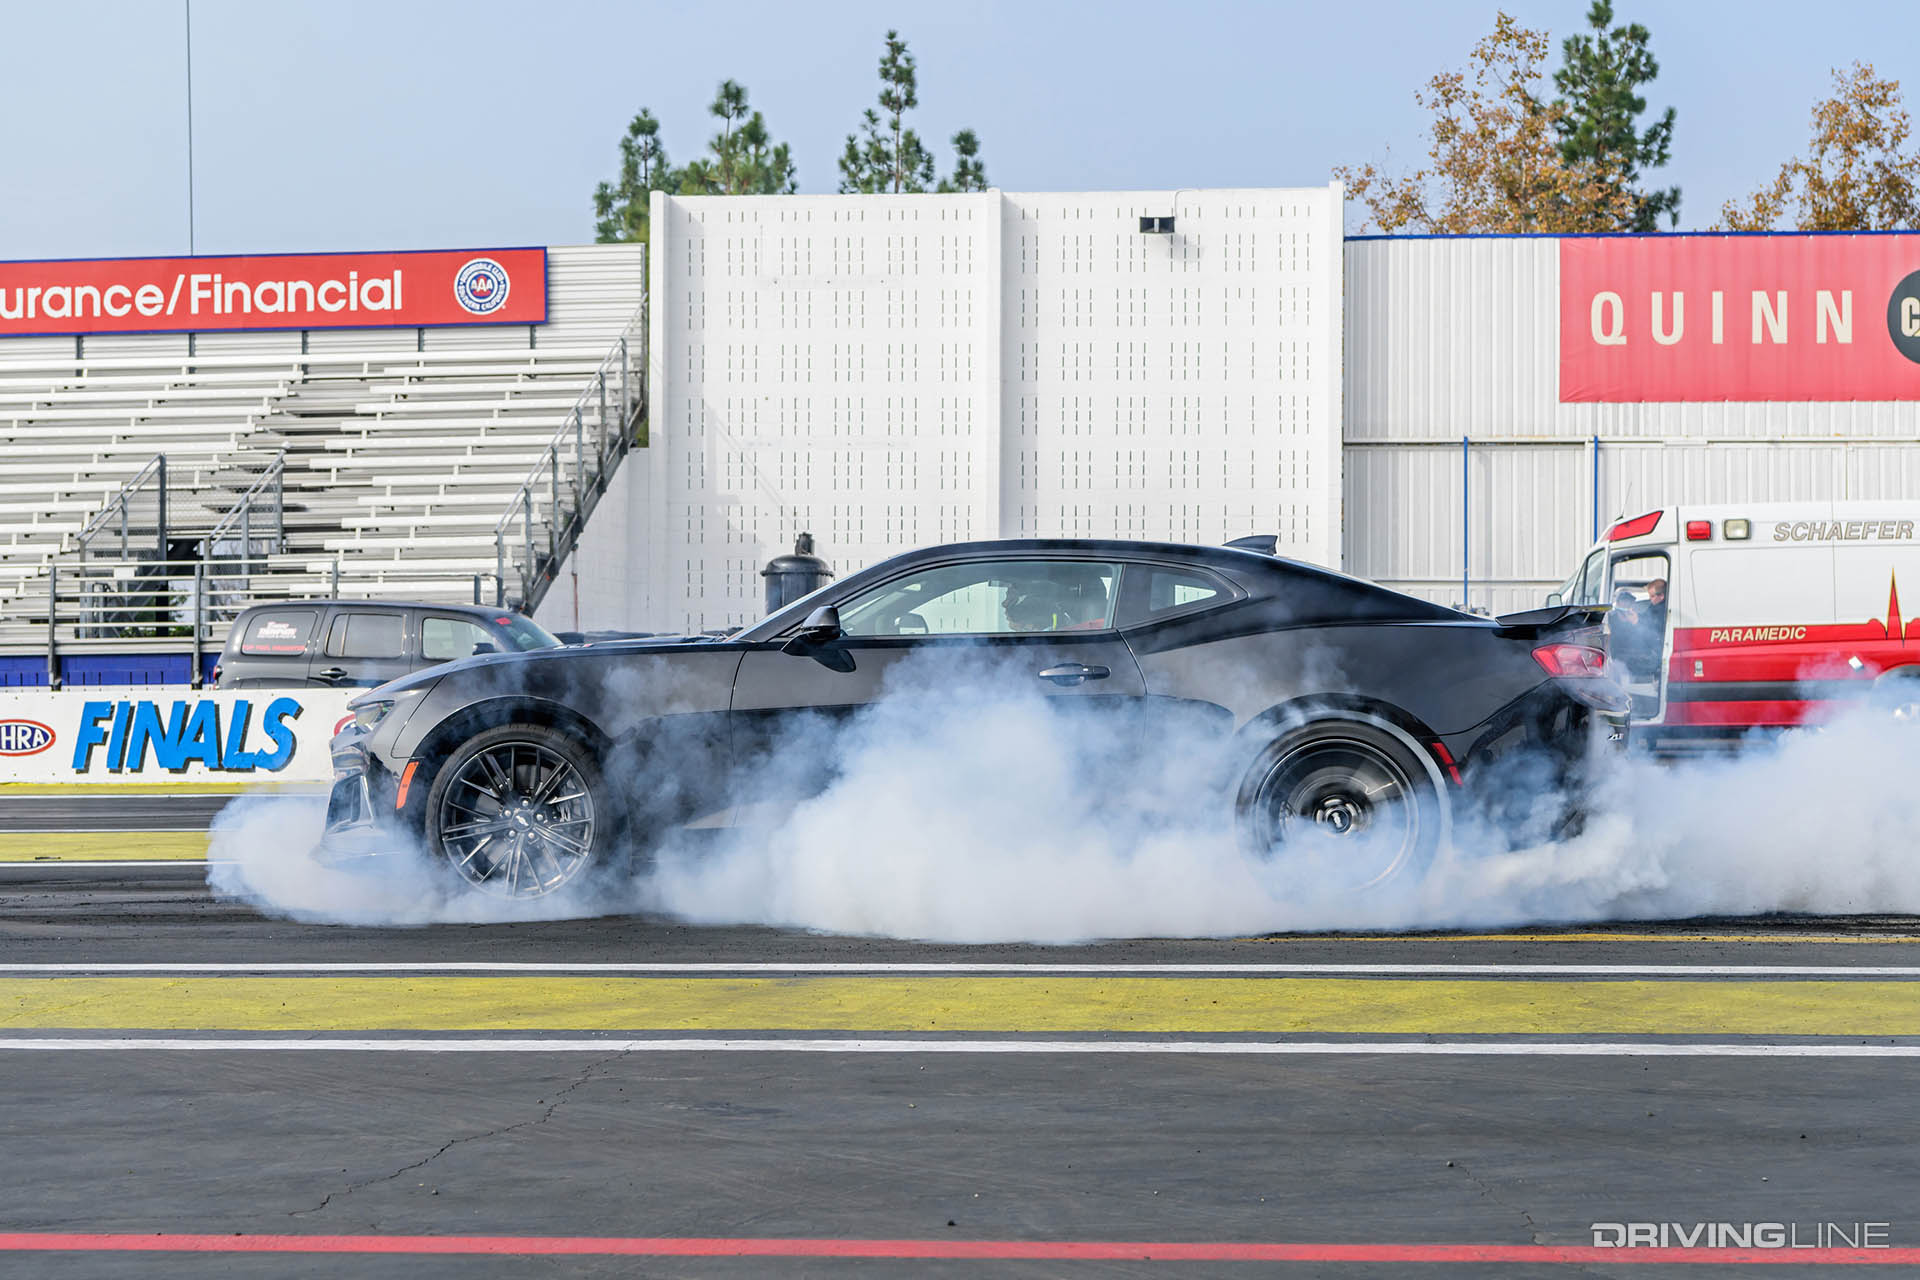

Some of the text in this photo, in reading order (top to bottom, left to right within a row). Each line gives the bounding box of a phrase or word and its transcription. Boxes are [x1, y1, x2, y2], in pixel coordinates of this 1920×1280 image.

[470, 278, 493, 292] AAA
[1590, 290, 1853, 346] QUINN
[1773, 521, 1914, 541] SCHAEFER
[1709, 626, 1807, 643] PARAMEDIC
[72, 697, 304, 774] FINALS
